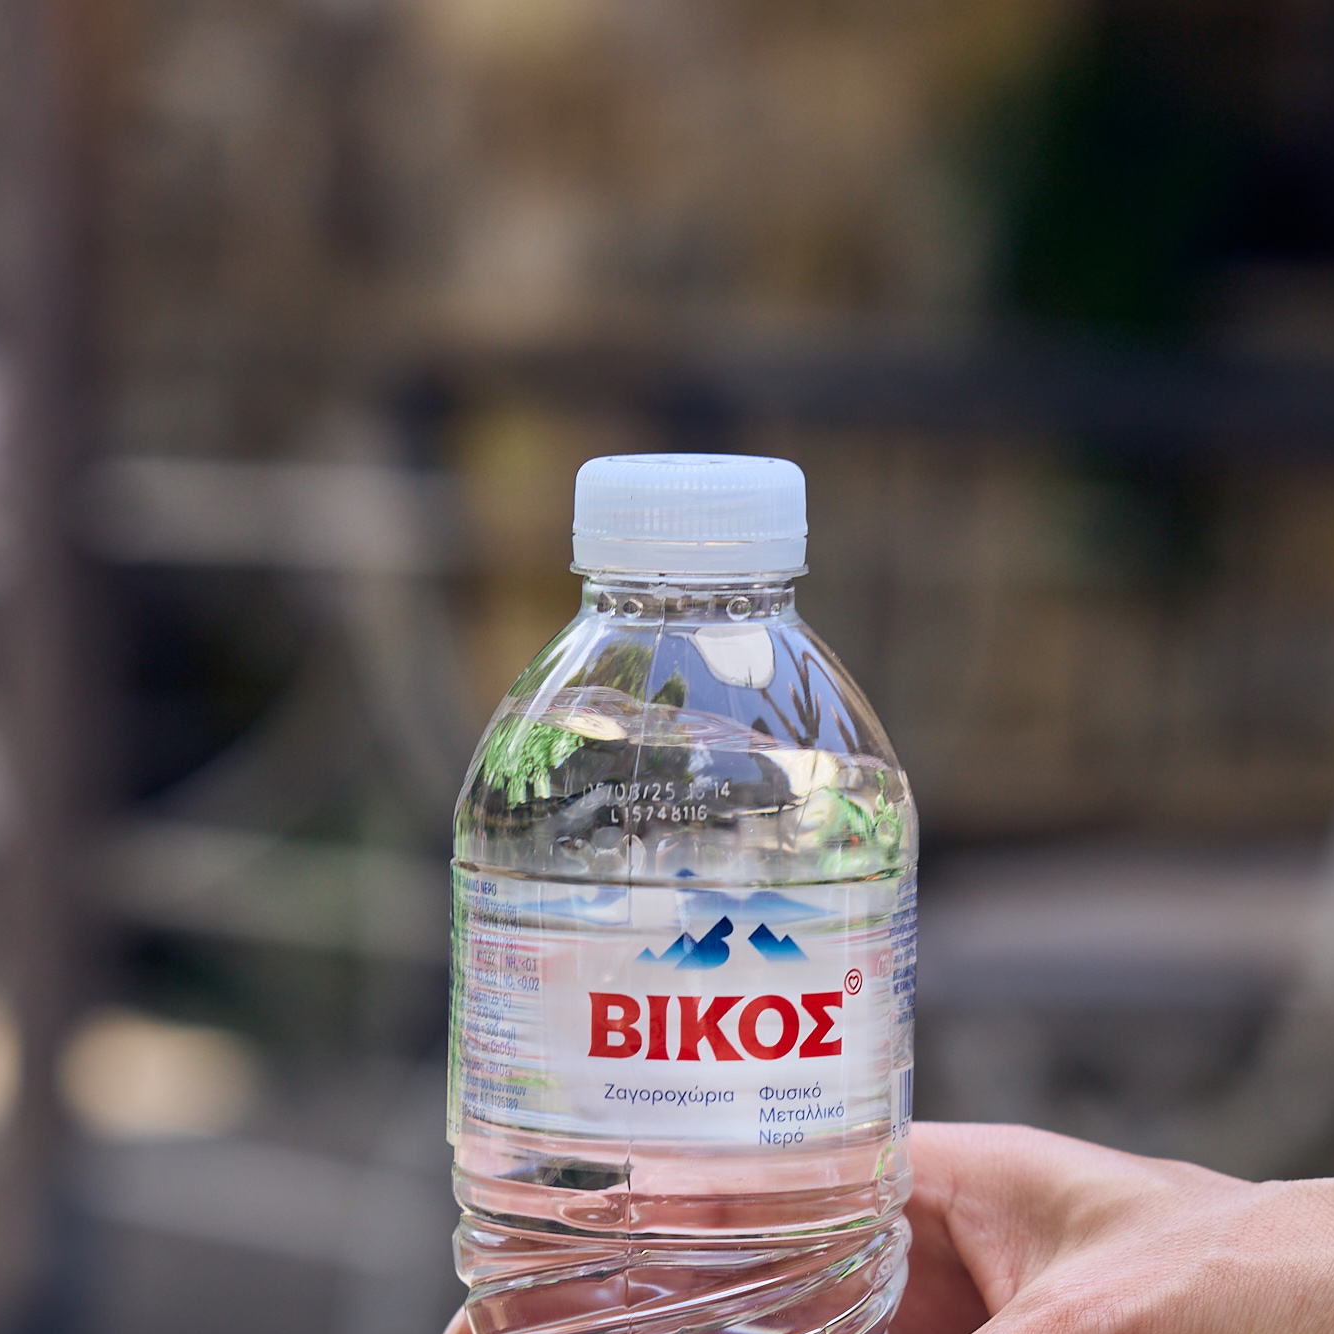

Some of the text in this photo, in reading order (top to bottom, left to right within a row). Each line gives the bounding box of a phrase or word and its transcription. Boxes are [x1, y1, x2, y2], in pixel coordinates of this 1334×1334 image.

[587, 990, 844, 1062] ΒΙΚΟΣ
[604, 1083, 735, 1107] Ζαγοροχώρια
[759, 1081, 822, 1101] Φυσικό
[759, 1100, 845, 1123] Μεταλλικό
[759, 1126, 804, 1149] Νερό
